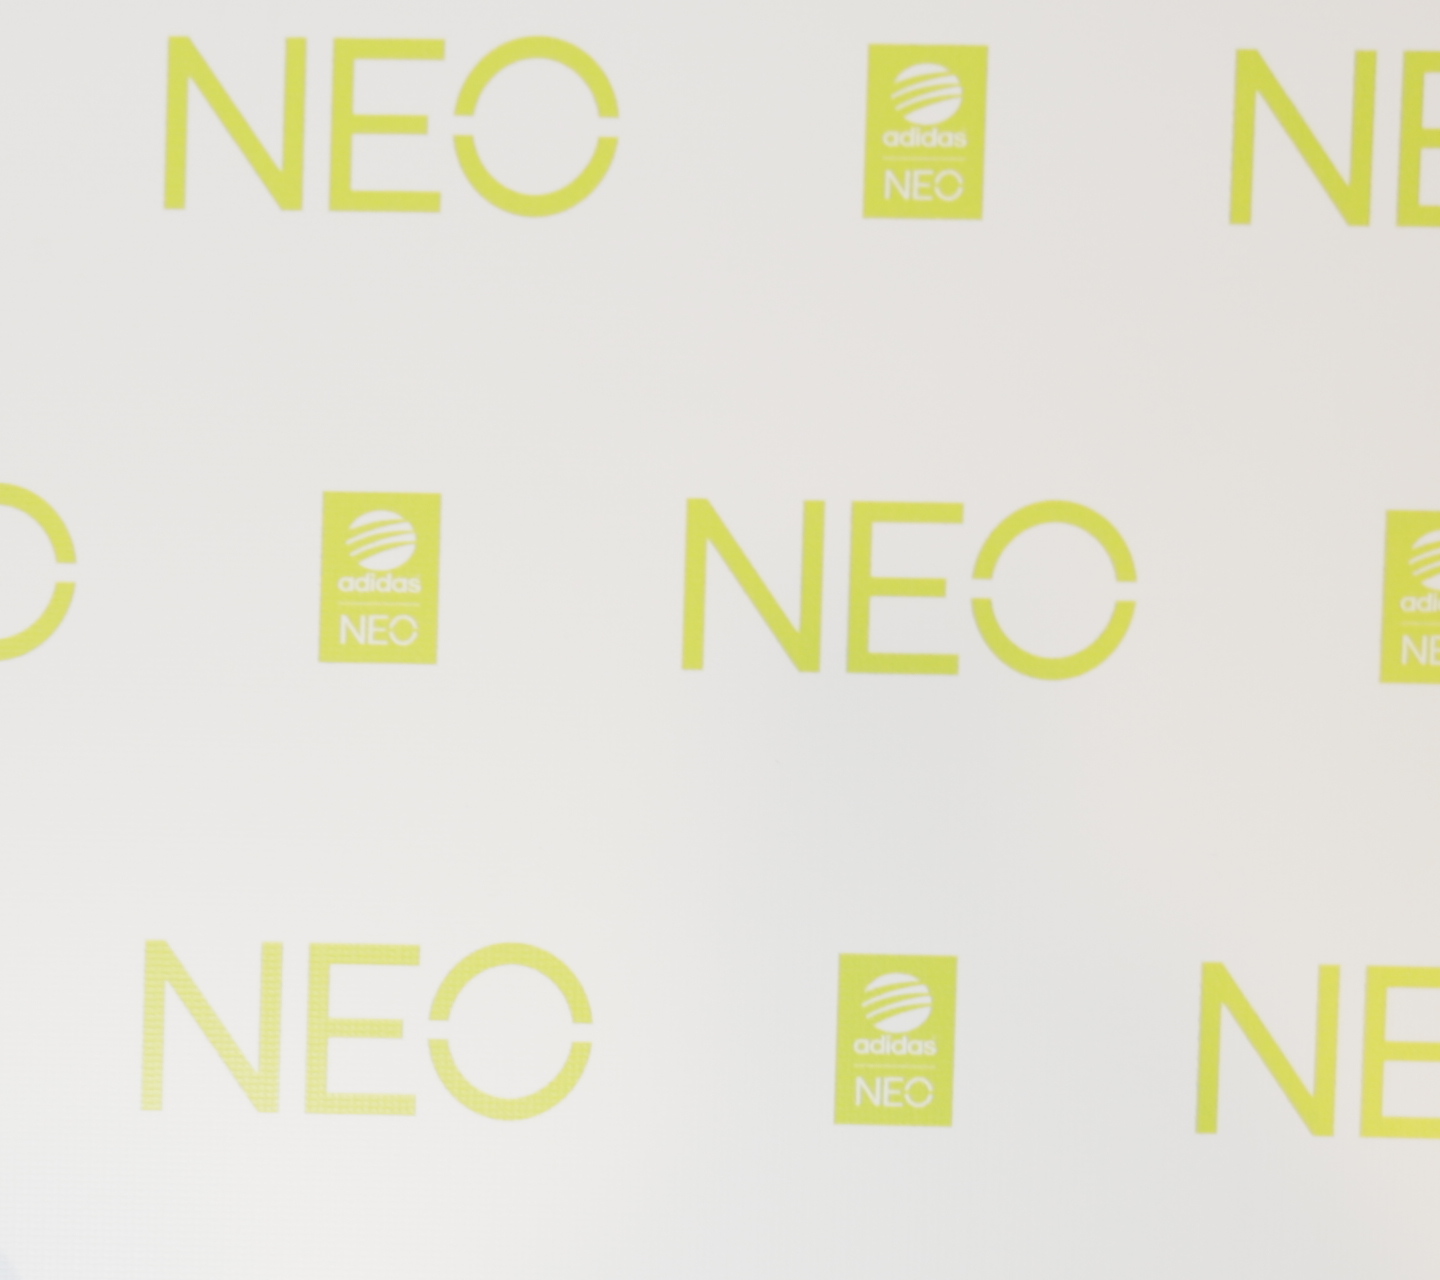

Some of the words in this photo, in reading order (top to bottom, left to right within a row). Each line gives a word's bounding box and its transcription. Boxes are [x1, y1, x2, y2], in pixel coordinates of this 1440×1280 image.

[165, 36, 618, 217] NEO
[882, 125, 967, 147] adidas
[883, 167, 964, 201] NEO
[337, 570, 421, 593] adidas
[683, 498, 1136, 680] NEO
[339, 611, 418, 646] NEO
[138, 939, 593, 1121] NEO
[852, 1033, 936, 1055] adidas
[854, 1073, 933, 1108] NEO
